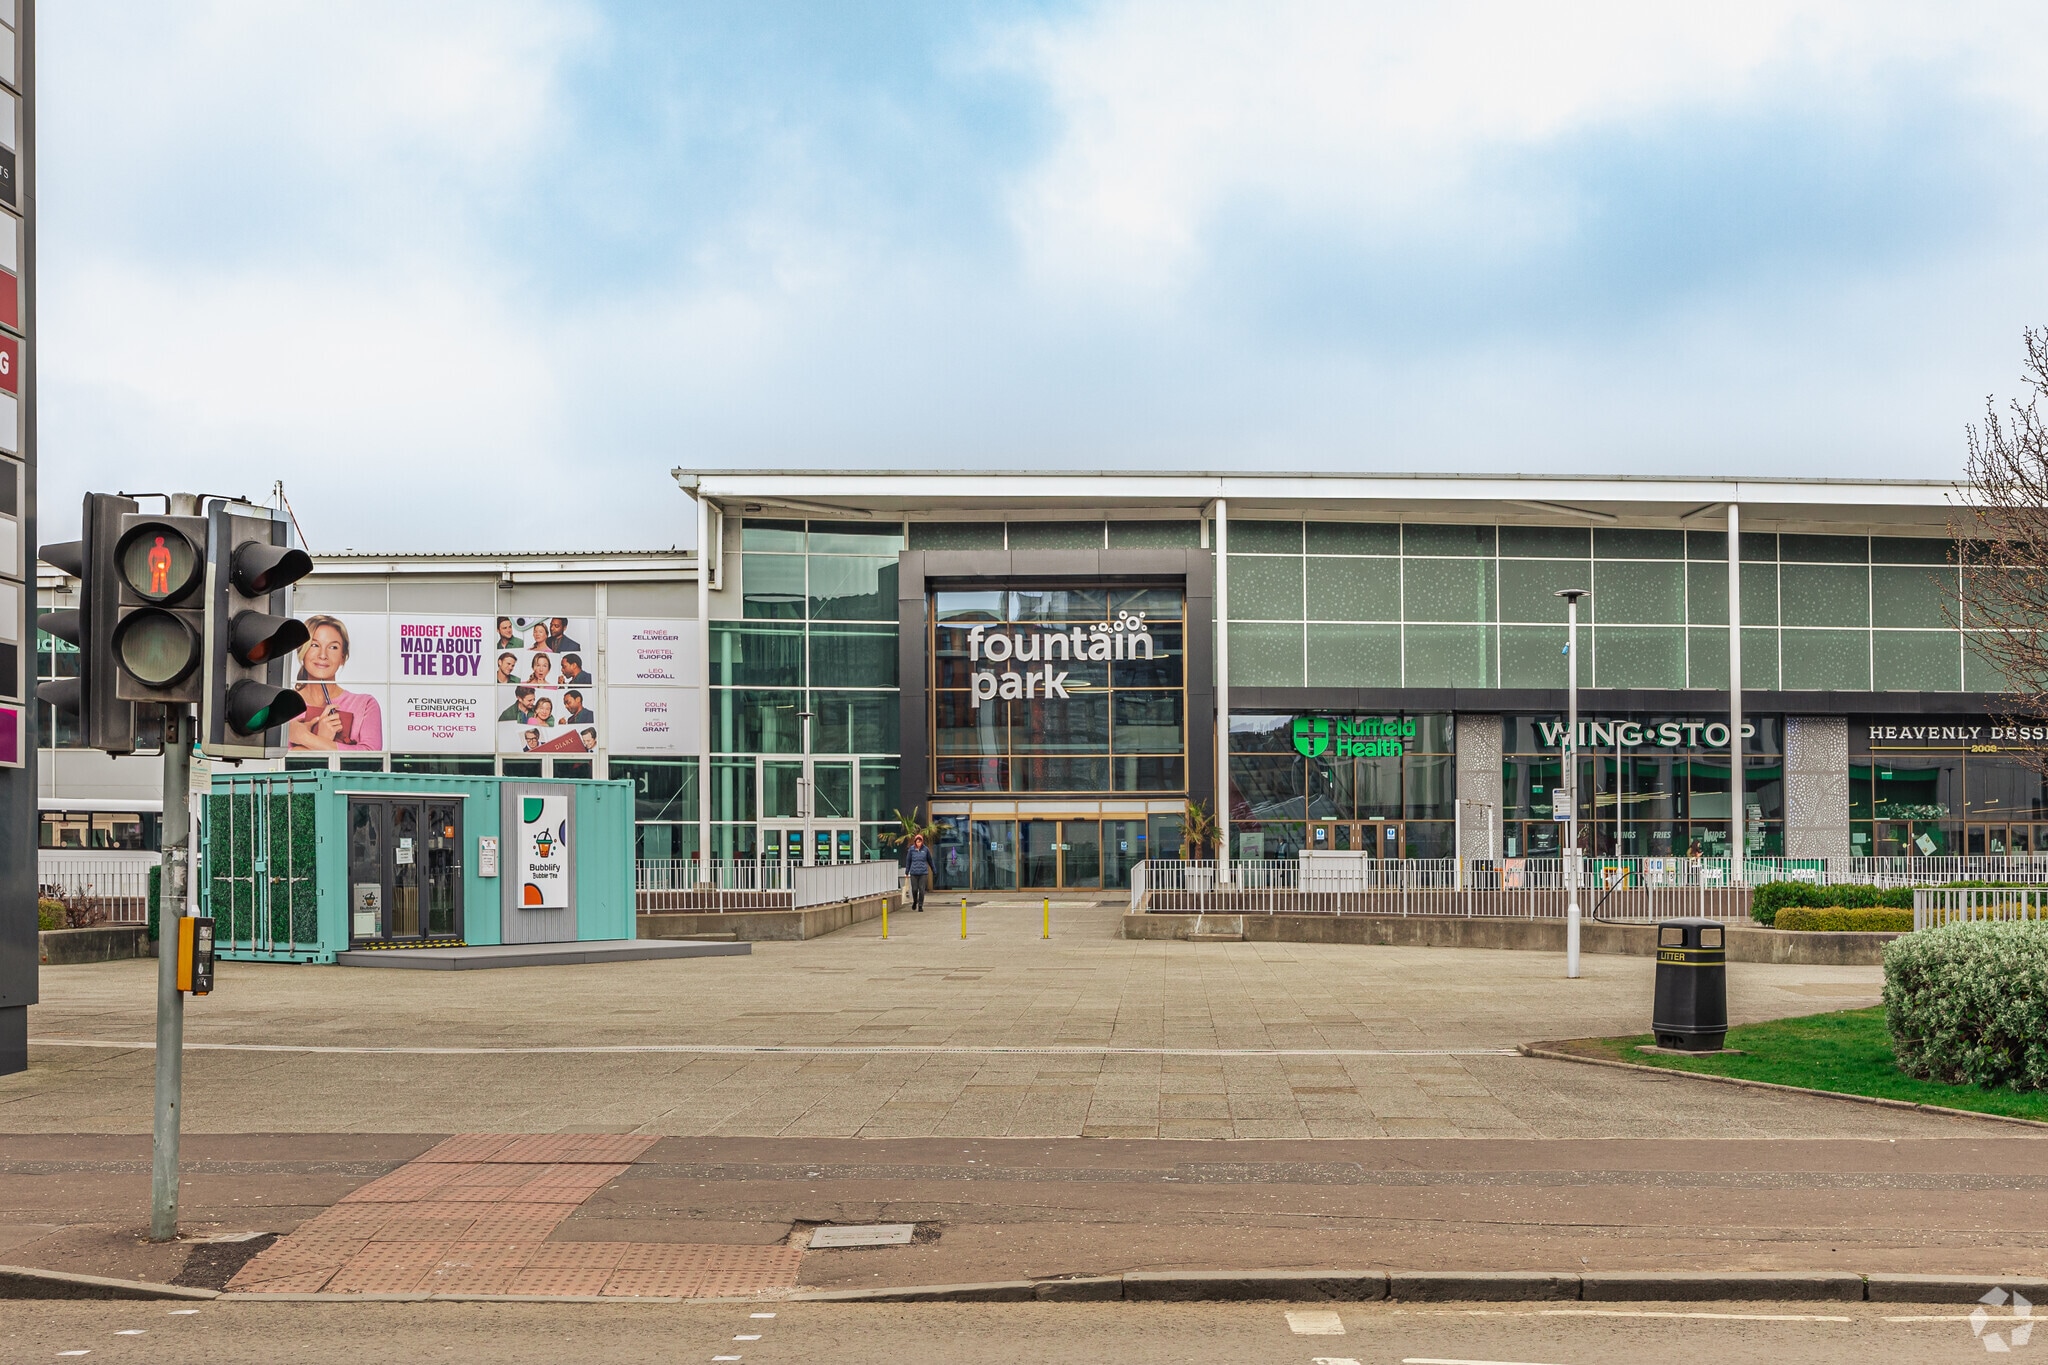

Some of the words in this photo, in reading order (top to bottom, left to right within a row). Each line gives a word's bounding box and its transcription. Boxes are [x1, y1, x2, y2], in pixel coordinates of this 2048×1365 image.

[401, 624, 445, 637] BRIDGET
[448, 626, 482, 638] JONES
[401, 637, 433, 653] MAD
[436, 638, 482, 653] ABOUT
[967, 624, 1153, 662] fountain
[401, 653, 437, 676] THE
[441, 654, 482, 676] BOY
[971, 664, 1070, 708] park
[408, 711, 462, 719] FEBRUARY
[414, 704, 470, 712] EDINBURGH
[407, 724, 435, 732] BOOK
[1336, 717, 1416, 737] Nuffield
[1869, 726, 1982, 740] HEAVENLY
[1990, 726, 2048, 741] DESS
[1336, 738, 1403, 757] Health
[1653, 831, 1671, 839] FRIES
[529, 863, 561, 873] Bubblify
[1660, 951, 1686, 961] LITTER
